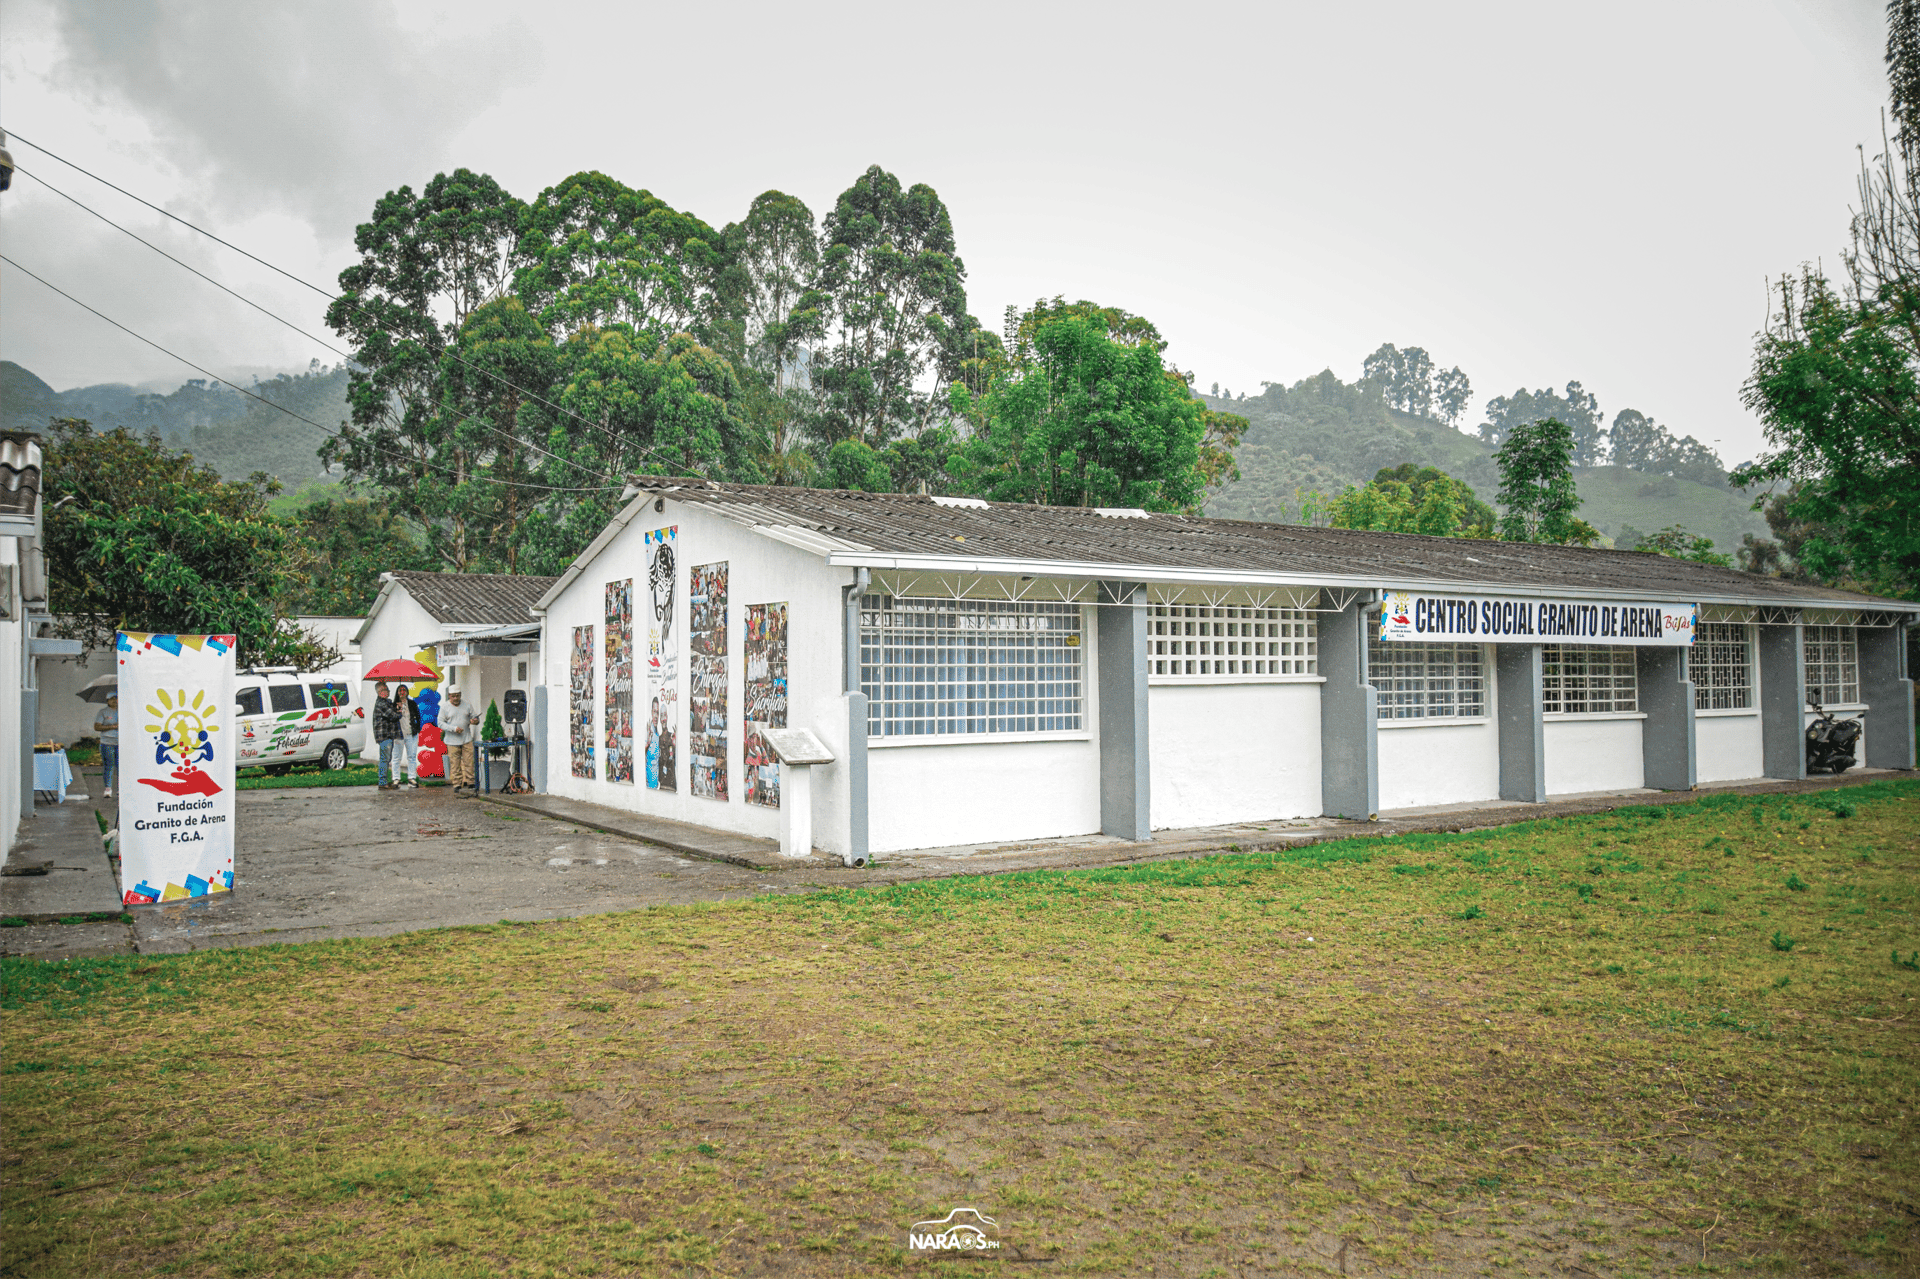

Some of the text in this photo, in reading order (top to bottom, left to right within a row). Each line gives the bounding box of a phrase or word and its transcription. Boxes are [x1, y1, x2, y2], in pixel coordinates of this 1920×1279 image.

[1415, 597, 1663, 638] CENTRO SOCIAL GRANITO DE ARENA
[692, 658, 728, 703] Entrega
[746, 683, 786, 727] Sacrificio
[276, 734, 311, 751] Felicidad
[157, 798, 213, 813] Fundación
[134, 814, 226, 830] Granito de Arena
[170, 830, 204, 843] F.G.A.
